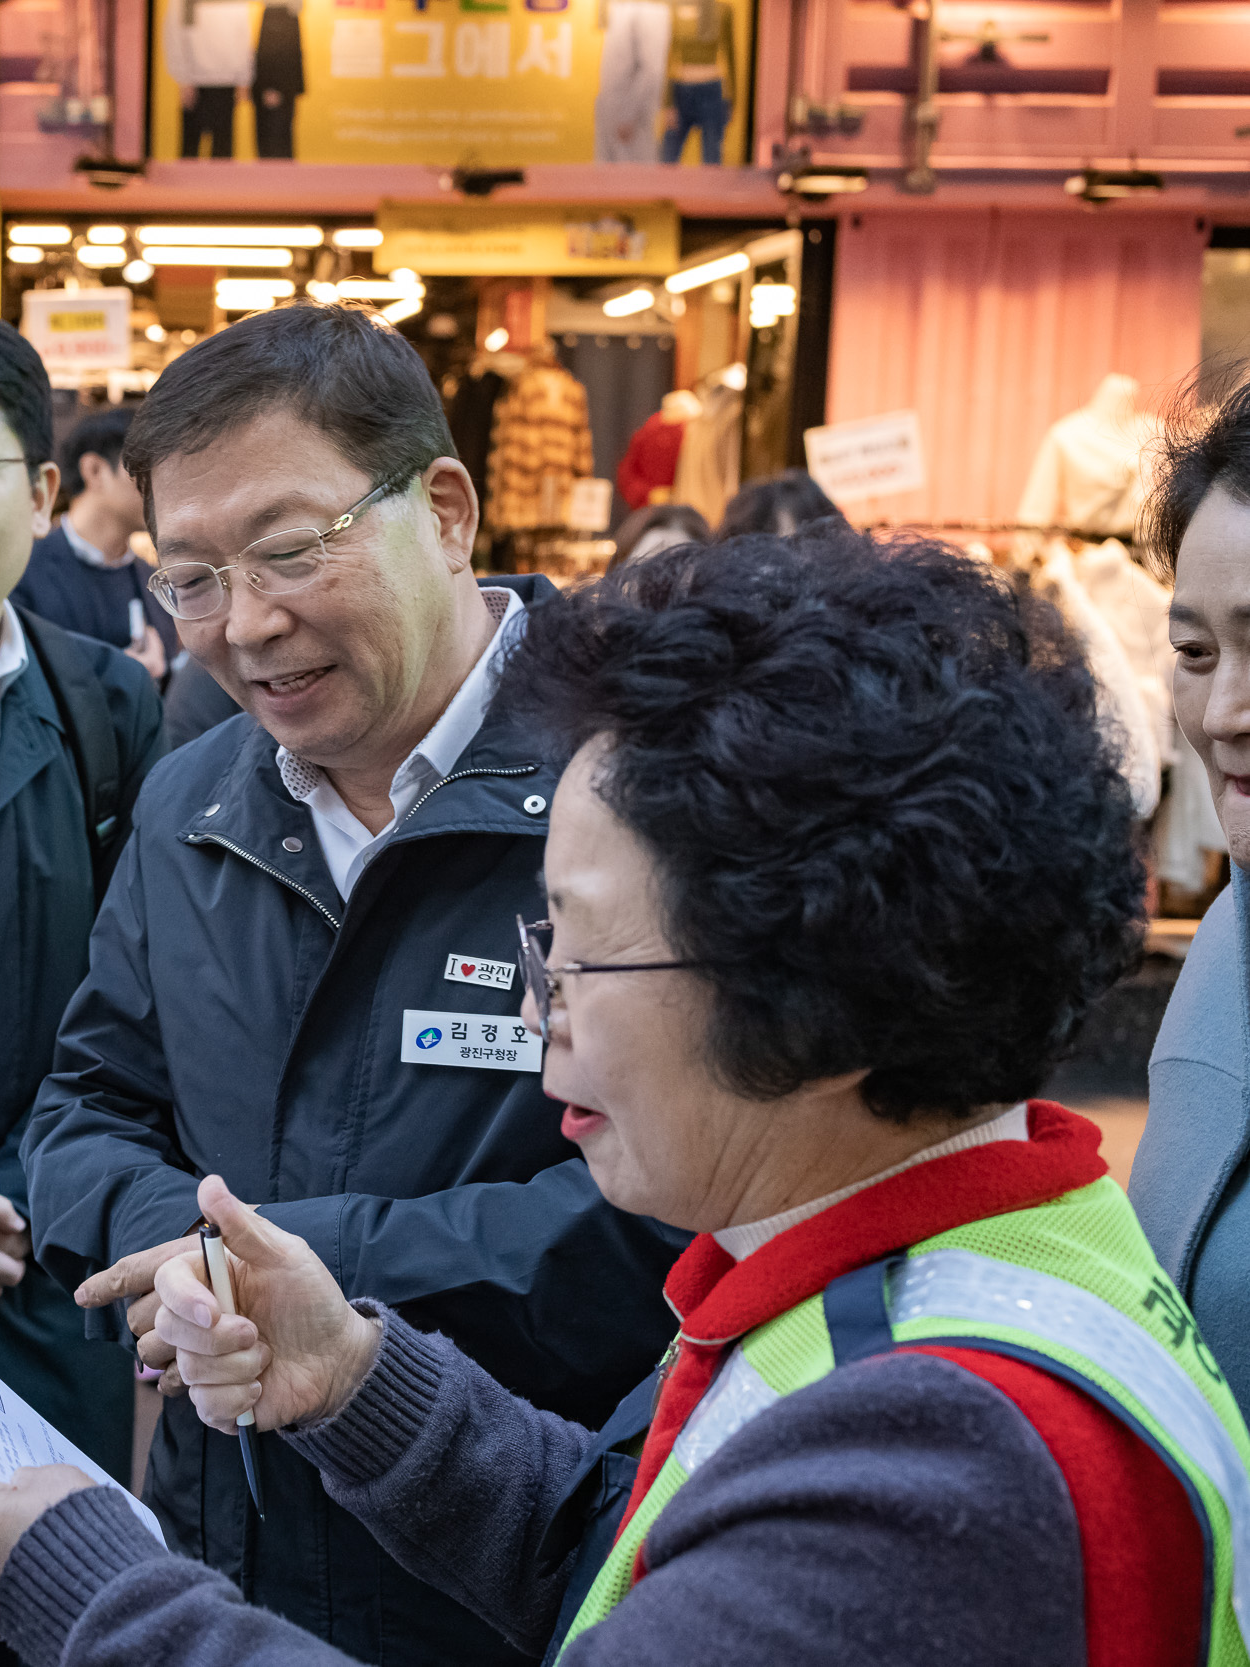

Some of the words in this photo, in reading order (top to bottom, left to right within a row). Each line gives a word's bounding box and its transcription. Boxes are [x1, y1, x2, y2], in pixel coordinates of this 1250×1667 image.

[448, 958, 458, 976] I
[478, 962, 513, 984] 광진
[459, 1046, 518, 1062] 광진구청장
